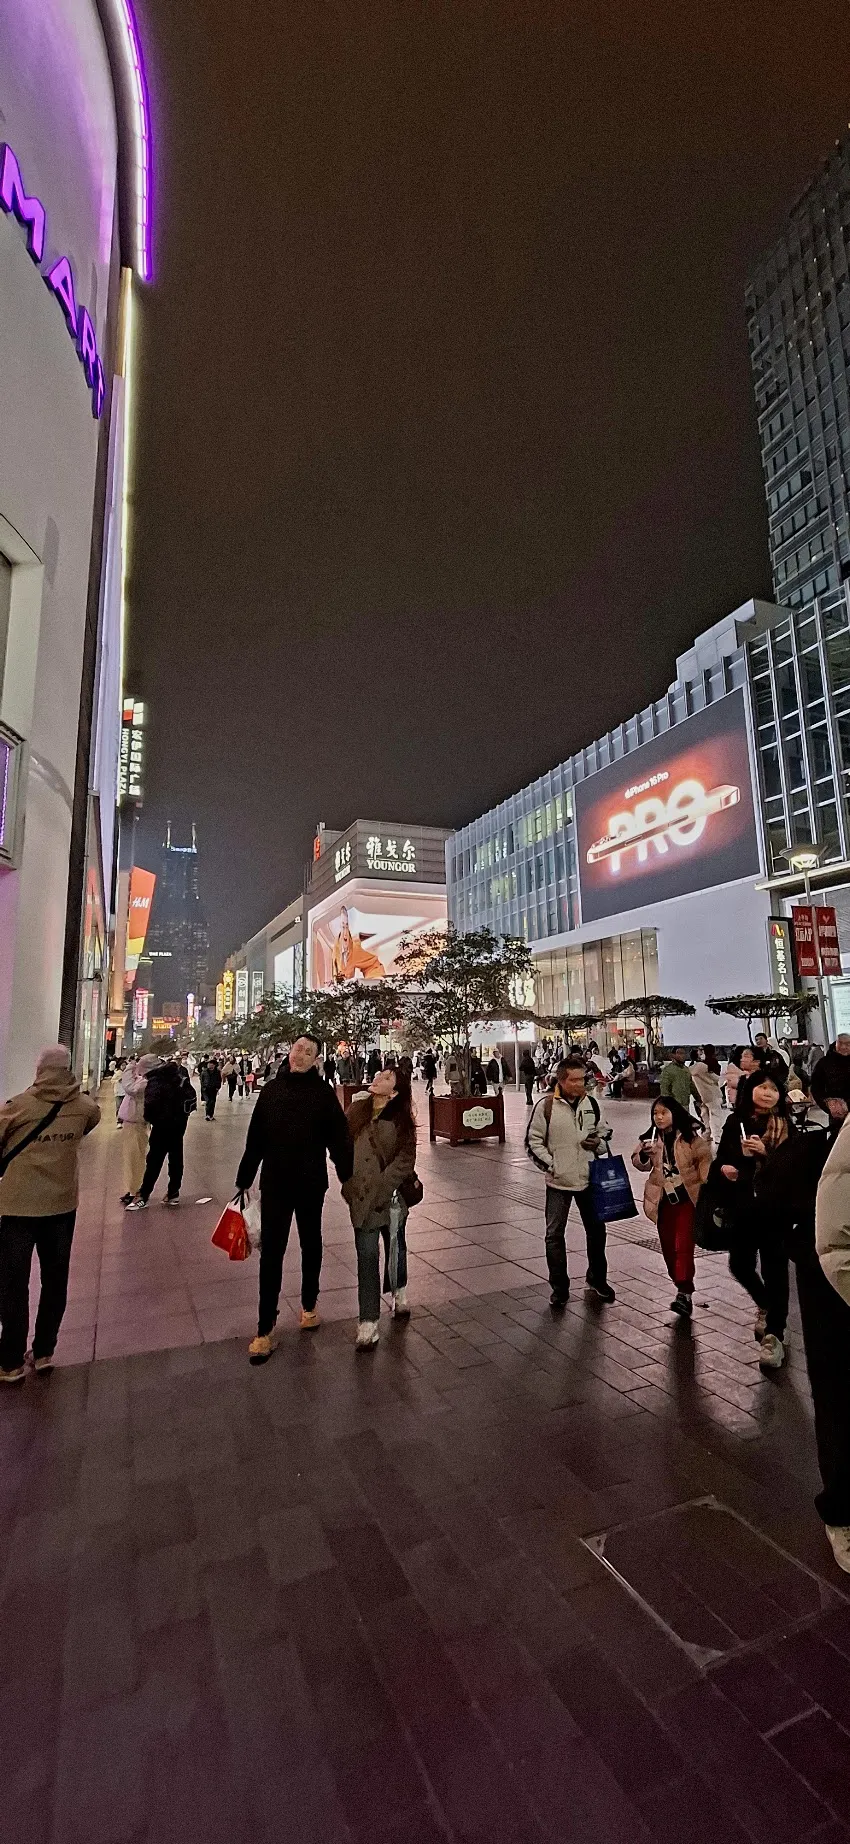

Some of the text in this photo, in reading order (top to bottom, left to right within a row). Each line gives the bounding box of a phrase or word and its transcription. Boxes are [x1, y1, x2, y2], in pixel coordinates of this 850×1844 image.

[119, 728, 129, 795] HONGYI PLAZA
[649, 775, 657, 787] 16
[657, 771, 669, 783] Pro
[366, 836, 415, 861] 雅戈尔
[609, 779, 707, 873] PRO
[366, 859, 416, 873] YOUNGOR
[775, 937, 792, 1035] 恒基名人购心
